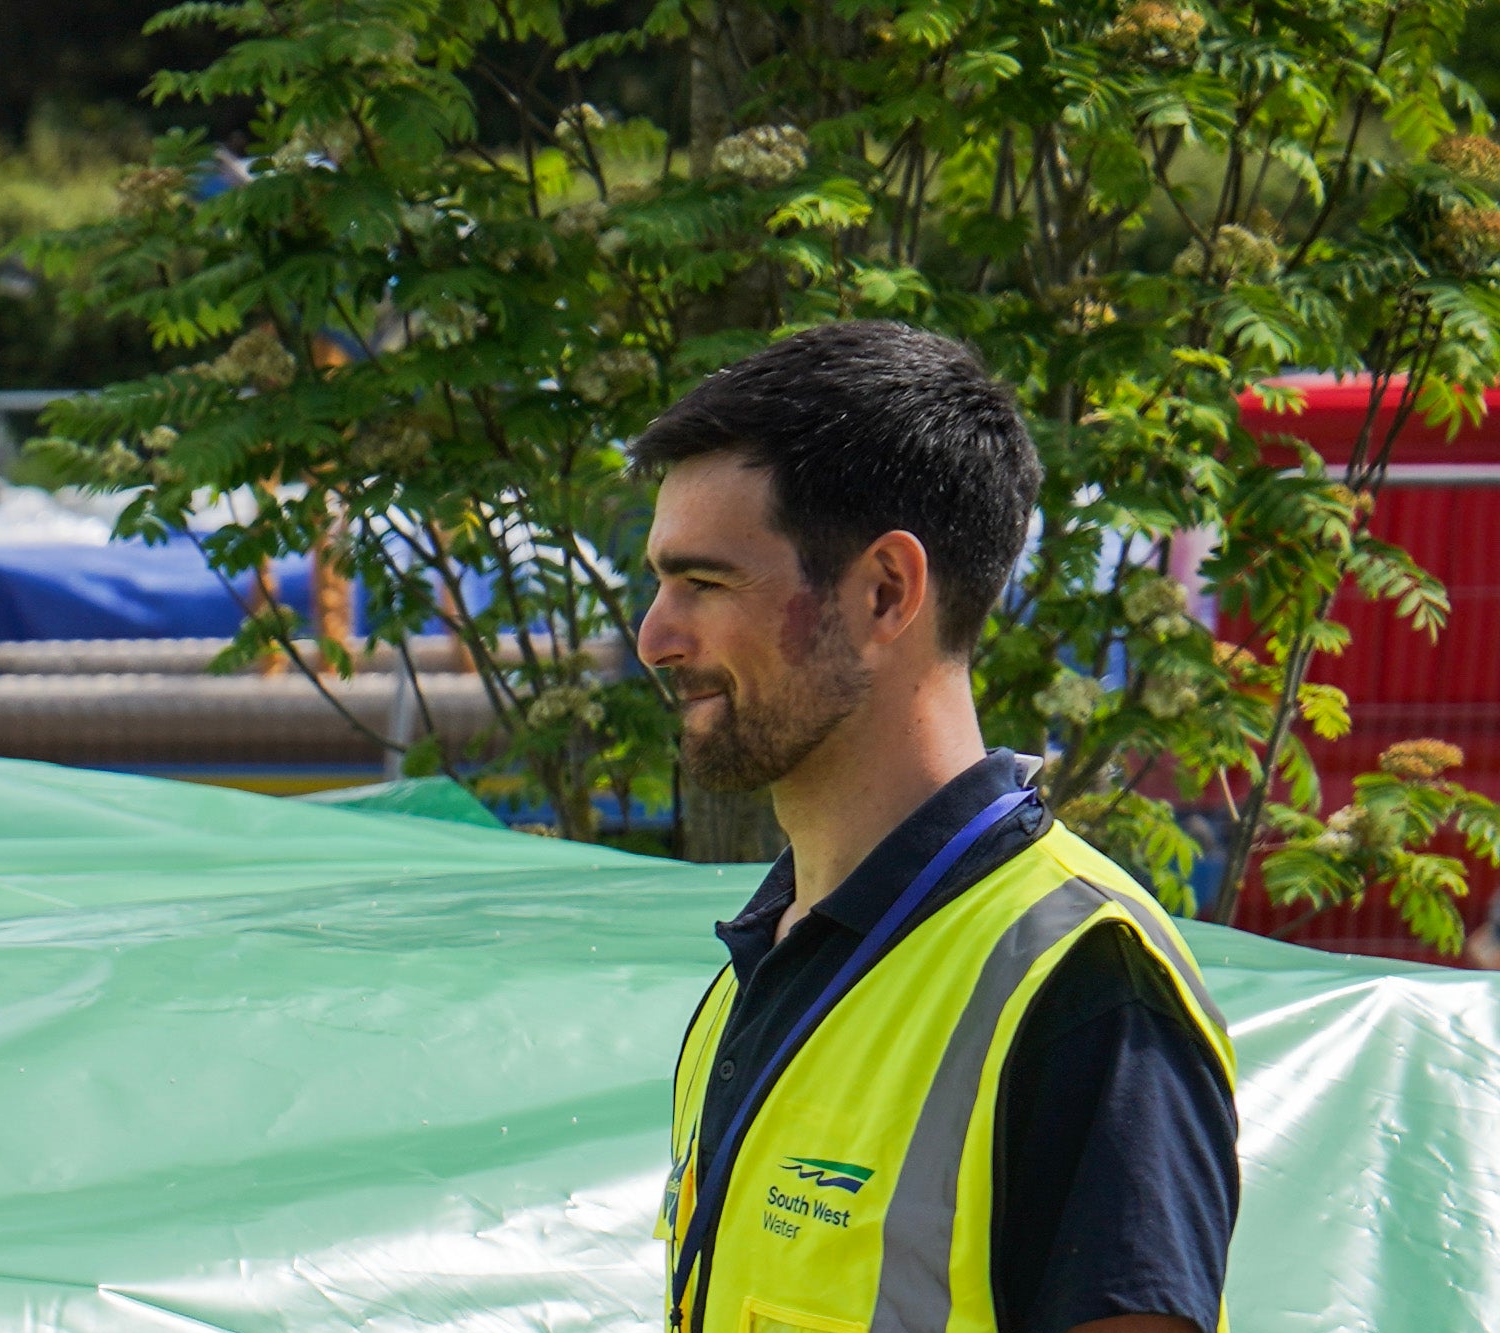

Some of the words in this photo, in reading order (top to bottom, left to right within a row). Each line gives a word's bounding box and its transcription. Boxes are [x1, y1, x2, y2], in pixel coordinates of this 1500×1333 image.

[768, 1185, 810, 1216] South
[813, 1199, 850, 1228] West
[763, 1210, 801, 1240] Water
